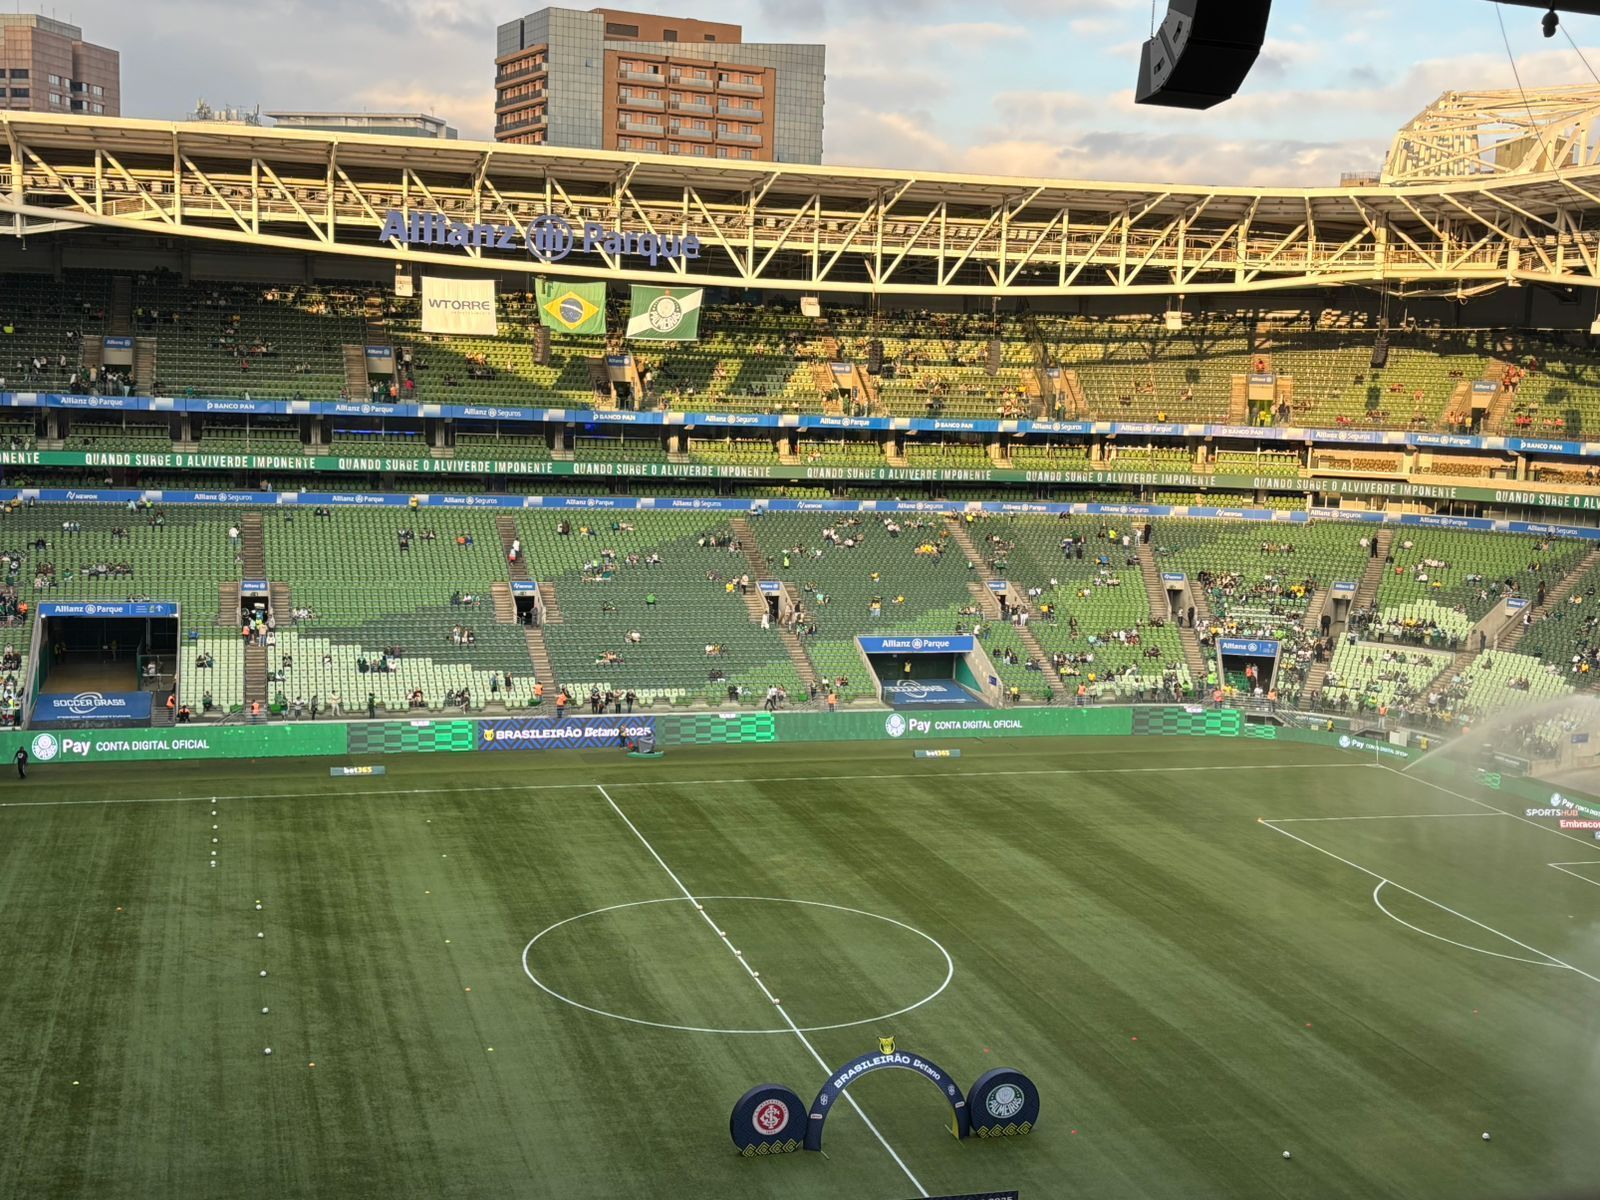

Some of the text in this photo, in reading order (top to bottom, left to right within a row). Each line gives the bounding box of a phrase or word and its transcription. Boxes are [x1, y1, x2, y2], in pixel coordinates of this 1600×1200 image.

[379, 211, 700, 266] Allianz Parque
[428, 298, 490, 310] WTORRE
[60, 397, 123, 407] Allianz Parque
[336, 404, 393, 414] Allianz Parque
[464, 408, 521, 418] Allianz Seguros
[736, 416, 758, 424] Seguros
[851, 419, 870, 427] Parque
[1061, 423, 1082, 431] Seguros
[1347, 433, 1370, 441] Seguros
[1450, 437, 1471, 446] Parque
[0, 452, 40, 464] NENTE
[86, 454, 315, 468] QUANDO SURGE O ALVIVERDE IMPONENTE
[338, 459, 552, 473] QUANDO SURGE O ALVIVERDE IMPONENTE
[574, 463, 770, 477] QUANDO SURGE O ALVIVERDE IMPONENTE
[807, 467, 991, 480] QUANDO SURGE O ALVIVERDE IMPONENTE
[1026, 472, 1216, 485] QUANDO SURGE O ALVIVERDE IMPONENTE
[1254, 477, 1456, 498] QUANDO SURGE O ALVIVERDE IMPONENTE
[228, 494, 252, 502] Seguros
[475, 498, 497, 506] Seguros
[1496, 490, 1535, 504] QUANDO
[1539, 494, 1569, 506] SURGE
[1574, 496, 1580, 507] O
[1339, 511, 1361, 519] Seguros
[1556, 527, 1577, 535] Seguros
[97, 605, 123, 614] Parque
[882, 639, 950, 650] Allianz Parque
[909, 718, 930, 733] Pay
[935, 720, 961, 730] CONTA
[962, 720, 992, 729] DIGITAL
[994, 720, 1022, 729] OFICIAL
[496, 727, 582, 740] BRASILEIRÃO
[584, 726, 619, 738] Betano
[63, 739, 91, 756] Pay
[96, 741, 130, 751] CONTA
[132, 740, 170, 750] DIGITAL
[172, 739, 209, 750] OFICIAL
[1352, 739, 1364, 749] Pay
[1562, 798, 1574, 809] Pay
[833, 1053, 941, 1089] BRASILEIRÃO Betano
